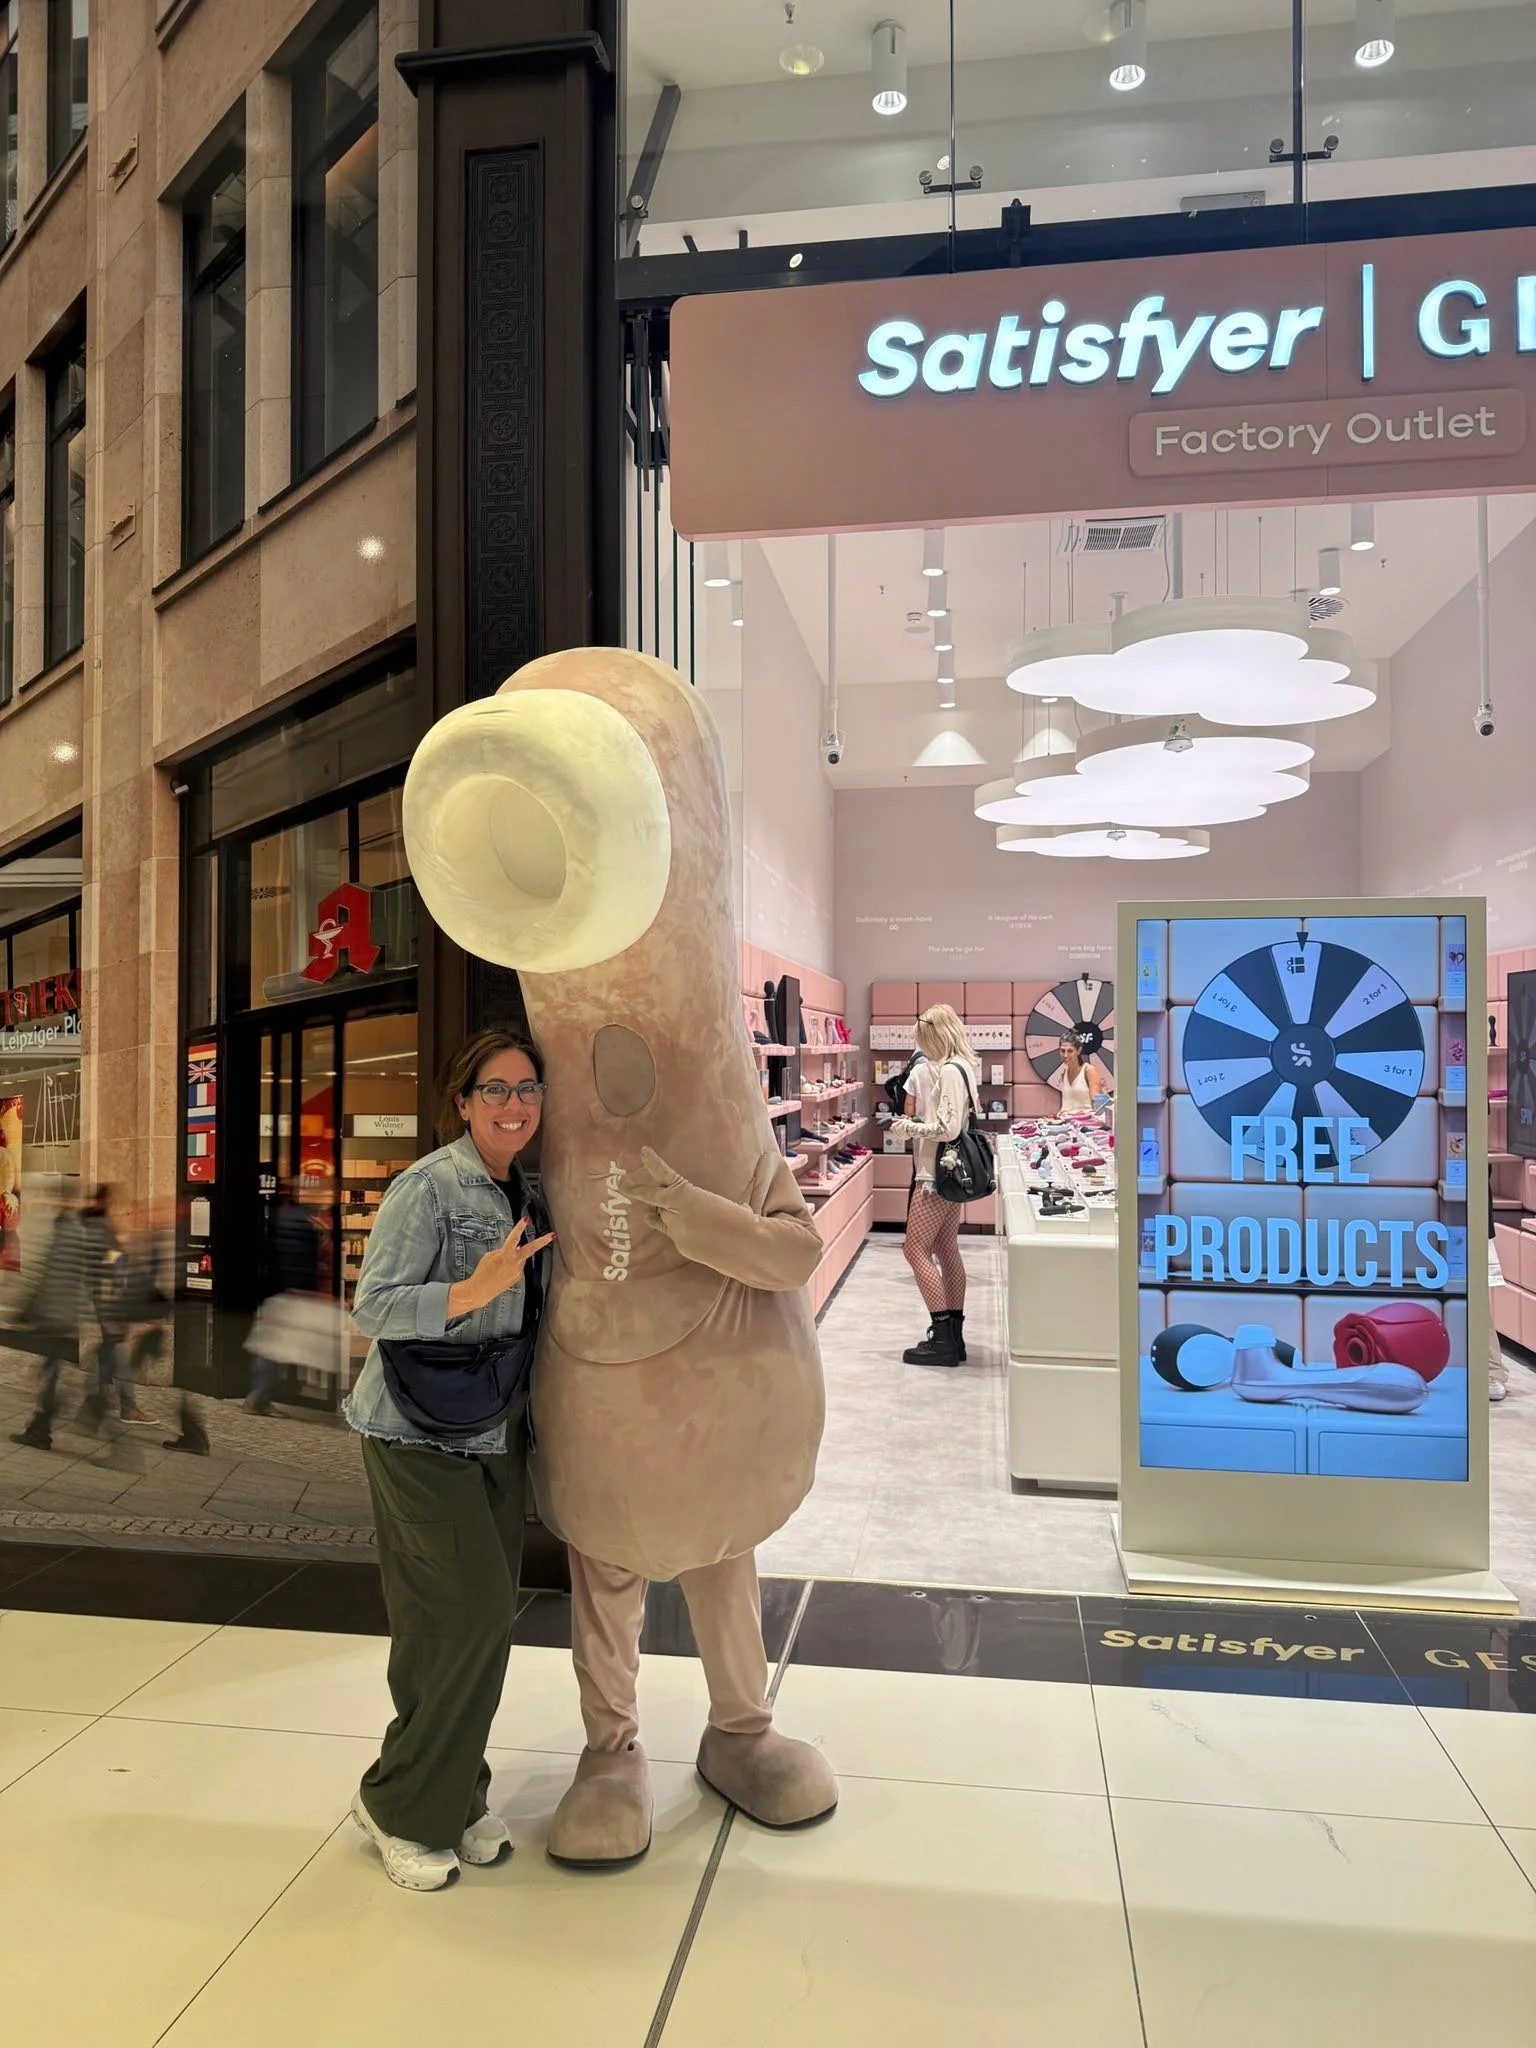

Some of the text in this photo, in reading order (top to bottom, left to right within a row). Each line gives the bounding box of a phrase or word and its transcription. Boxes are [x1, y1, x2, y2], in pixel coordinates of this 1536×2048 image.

[858, 295, 1324, 398] Satisfyer
[1155, 405, 1497, 456] Factory Outlet
[0, 968, 81, 1027] THEK
[1218, 996, 1231, 1008] for
[1362, 997, 1370, 1005] 2
[1369, 988, 1381, 1000] for
[2, 1025, 60, 1052] Leipziger
[1204, 1074, 1217, 1083] for
[1384, 1064, 1391, 1073] 3
[1392, 1066, 1406, 1075] for
[374, 1121, 404, 1129] Widmer
[1230, 1115, 1370, 1184] FREE
[601, 1160, 632, 1281] Satisfyer
[1155, 1214, 1449, 1290] PRODUCTS
[1100, 1629, 1365, 1661] Satisfyer
